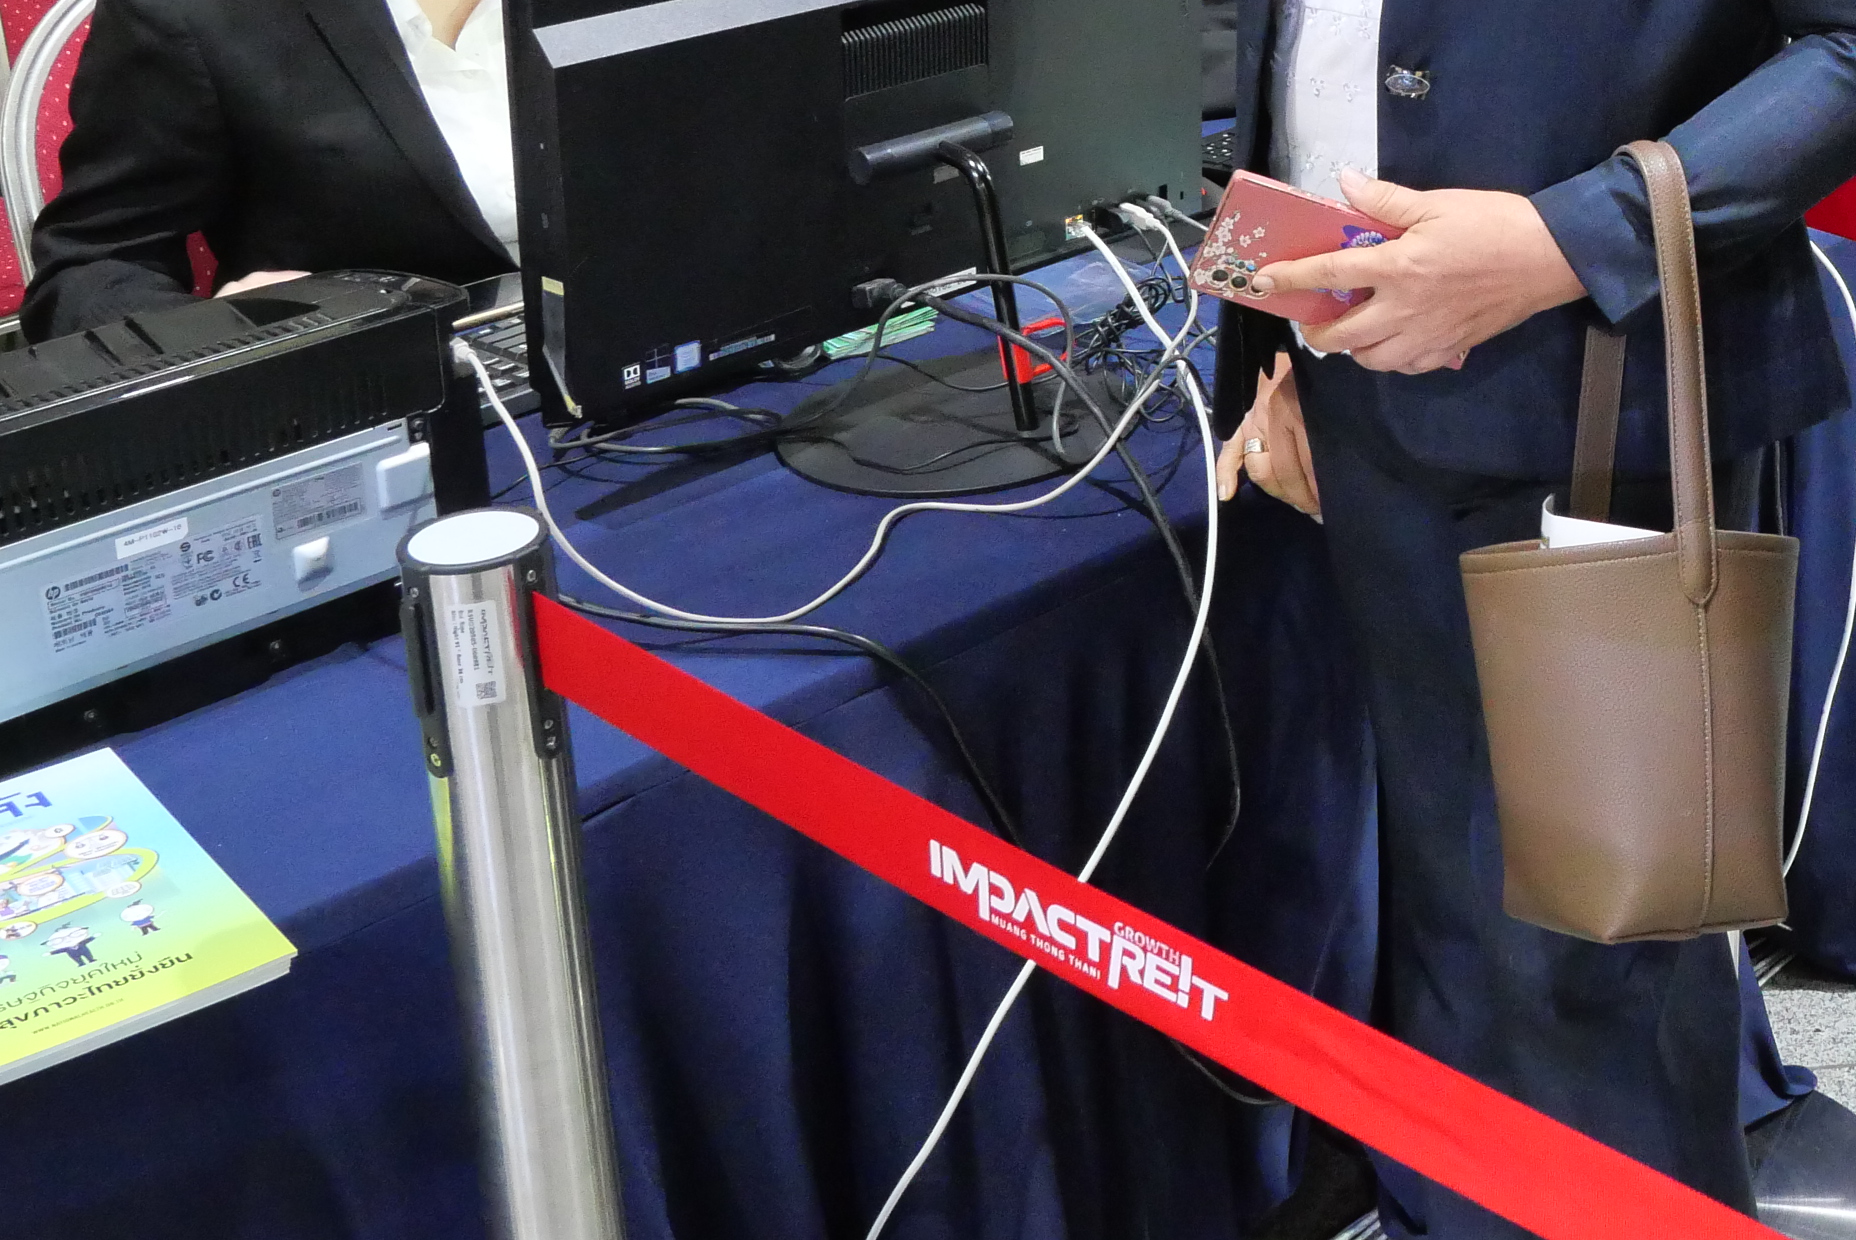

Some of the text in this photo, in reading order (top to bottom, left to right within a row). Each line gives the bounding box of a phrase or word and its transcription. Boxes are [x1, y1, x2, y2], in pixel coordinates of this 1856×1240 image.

[929, 838, 1112, 963] IMPACT
[990, 913, 1102, 981] MUANG THONG THANI
[1113, 920, 1181, 964] GROWTH
